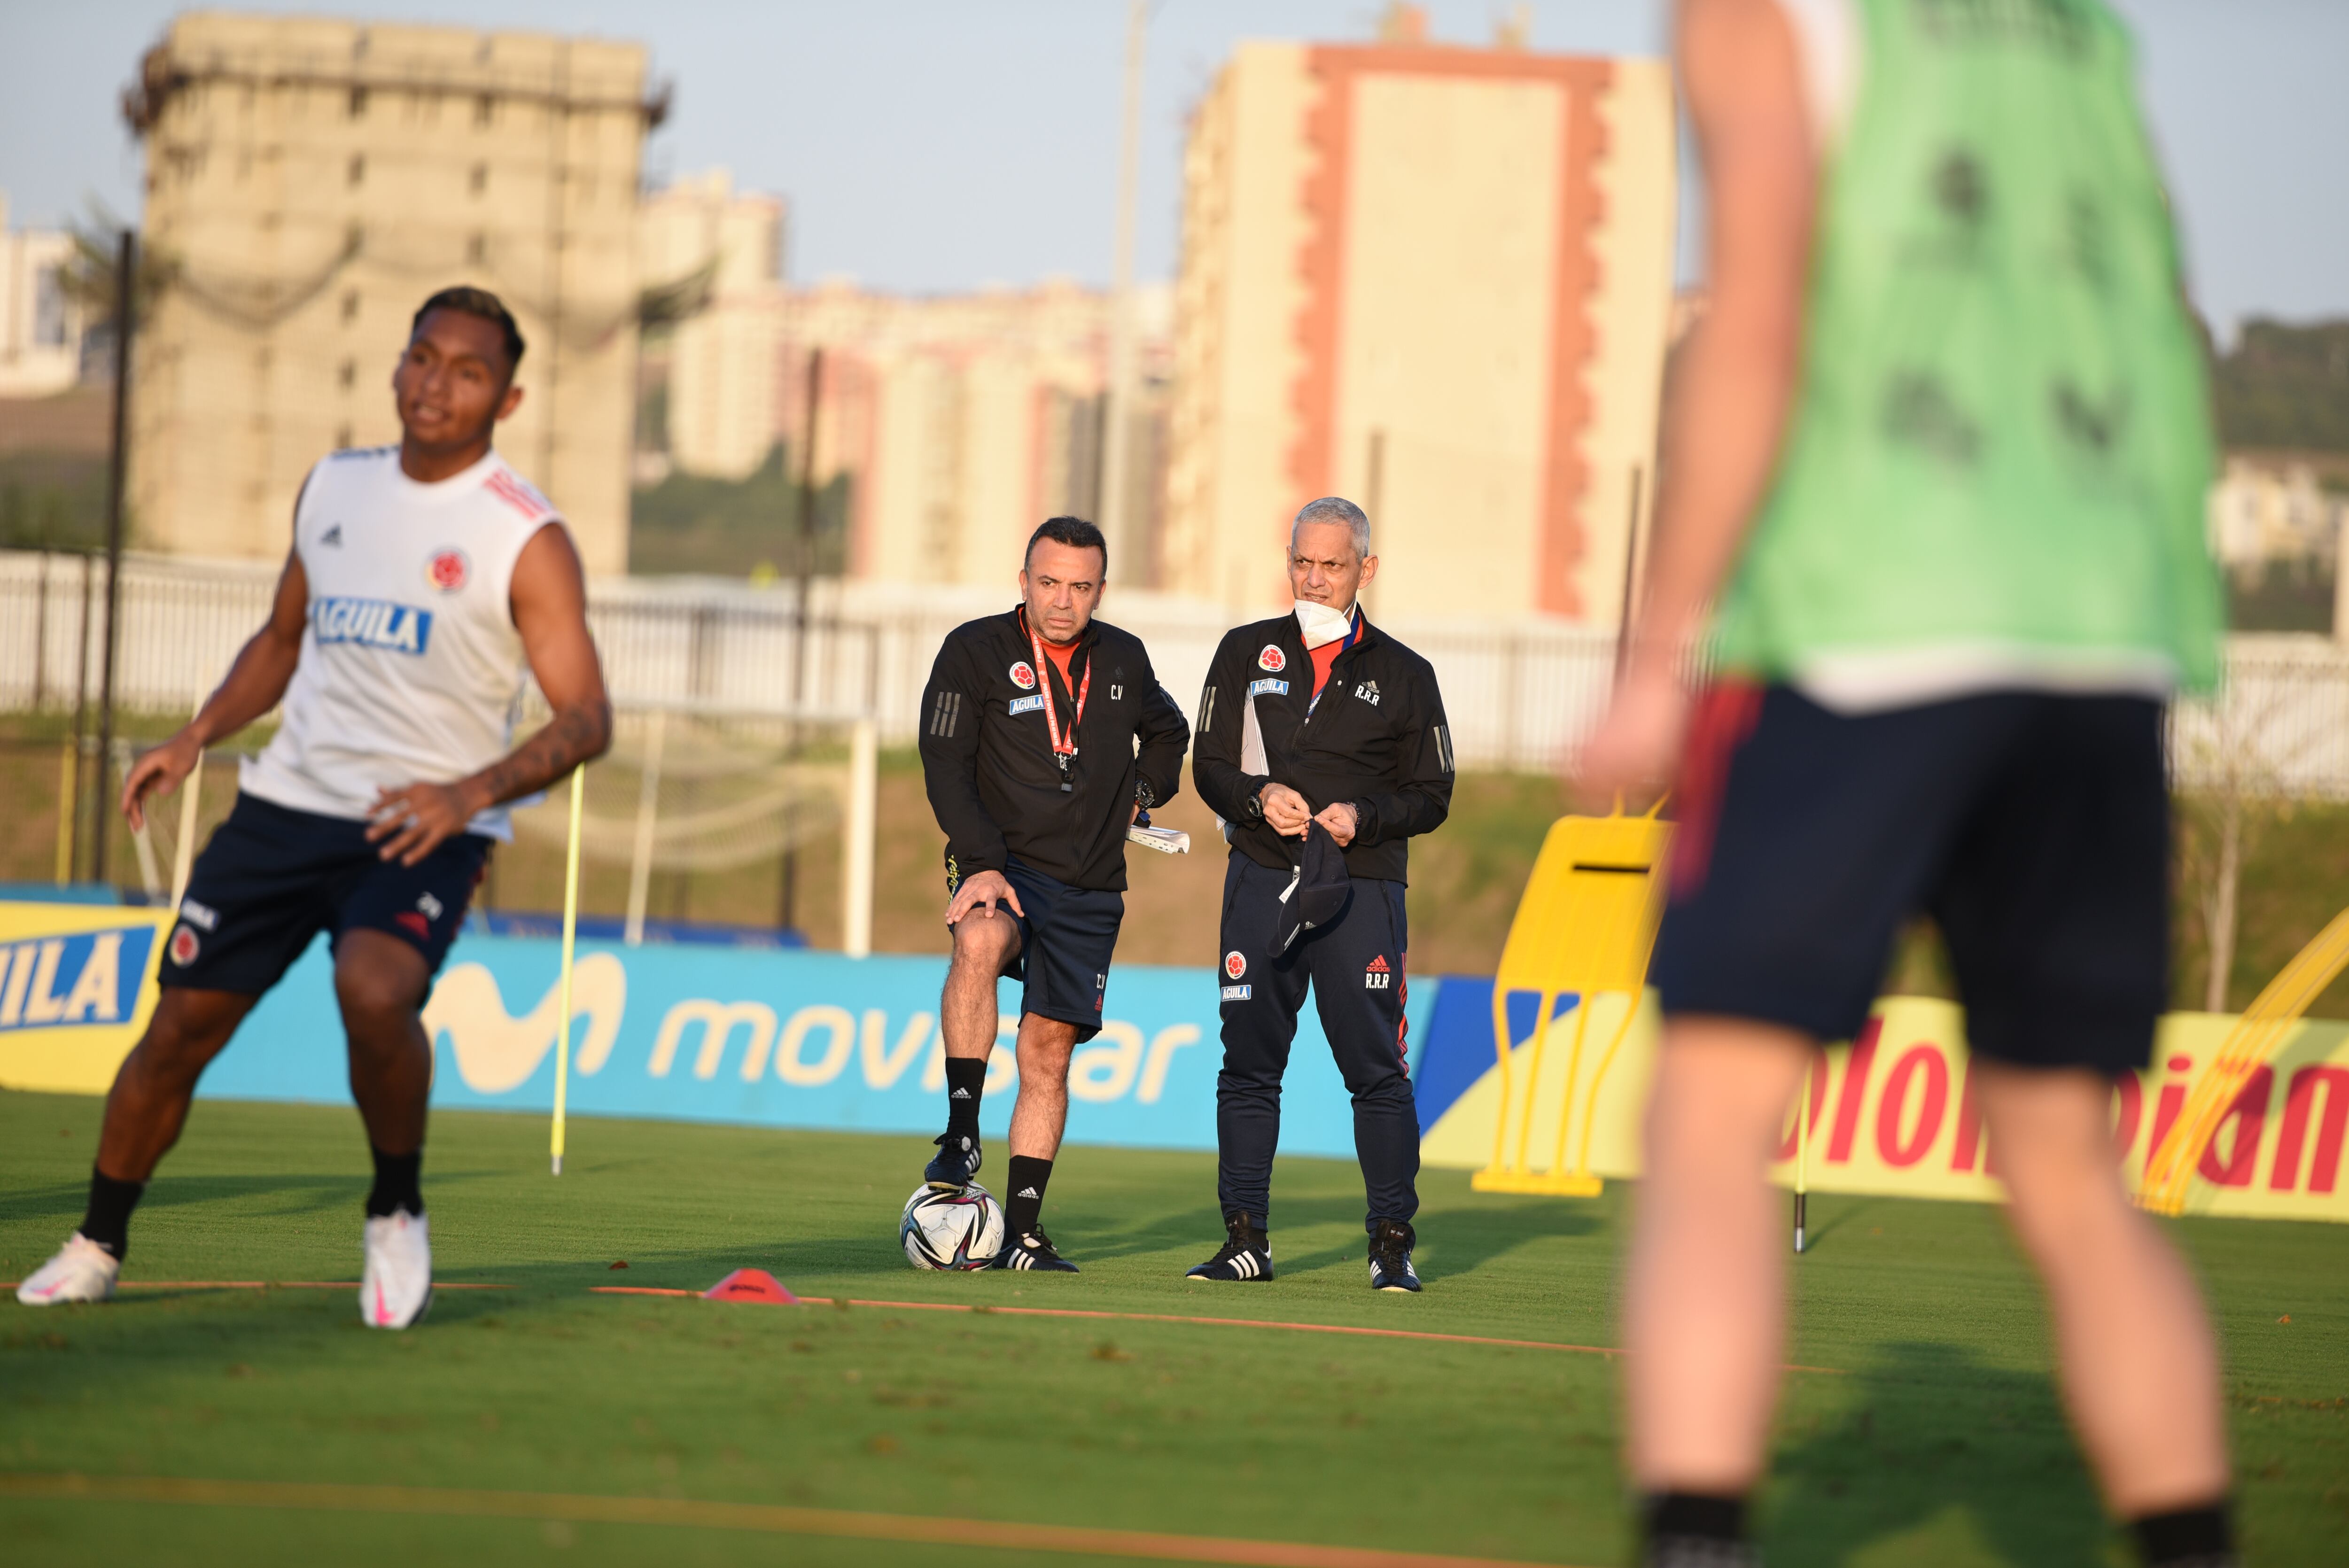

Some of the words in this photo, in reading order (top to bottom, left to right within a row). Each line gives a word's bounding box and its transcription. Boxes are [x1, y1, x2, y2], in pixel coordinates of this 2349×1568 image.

[1253, 680, 1284, 694] AGUILA
[1354, 684, 1380, 706] R.R.R
[1011, 696, 1044, 713] AGUILA
[1365, 973, 1390, 989] R.R.R
[1222, 986, 1248, 1000] AGUILA
[966, 1190, 983, 1199] adidas
